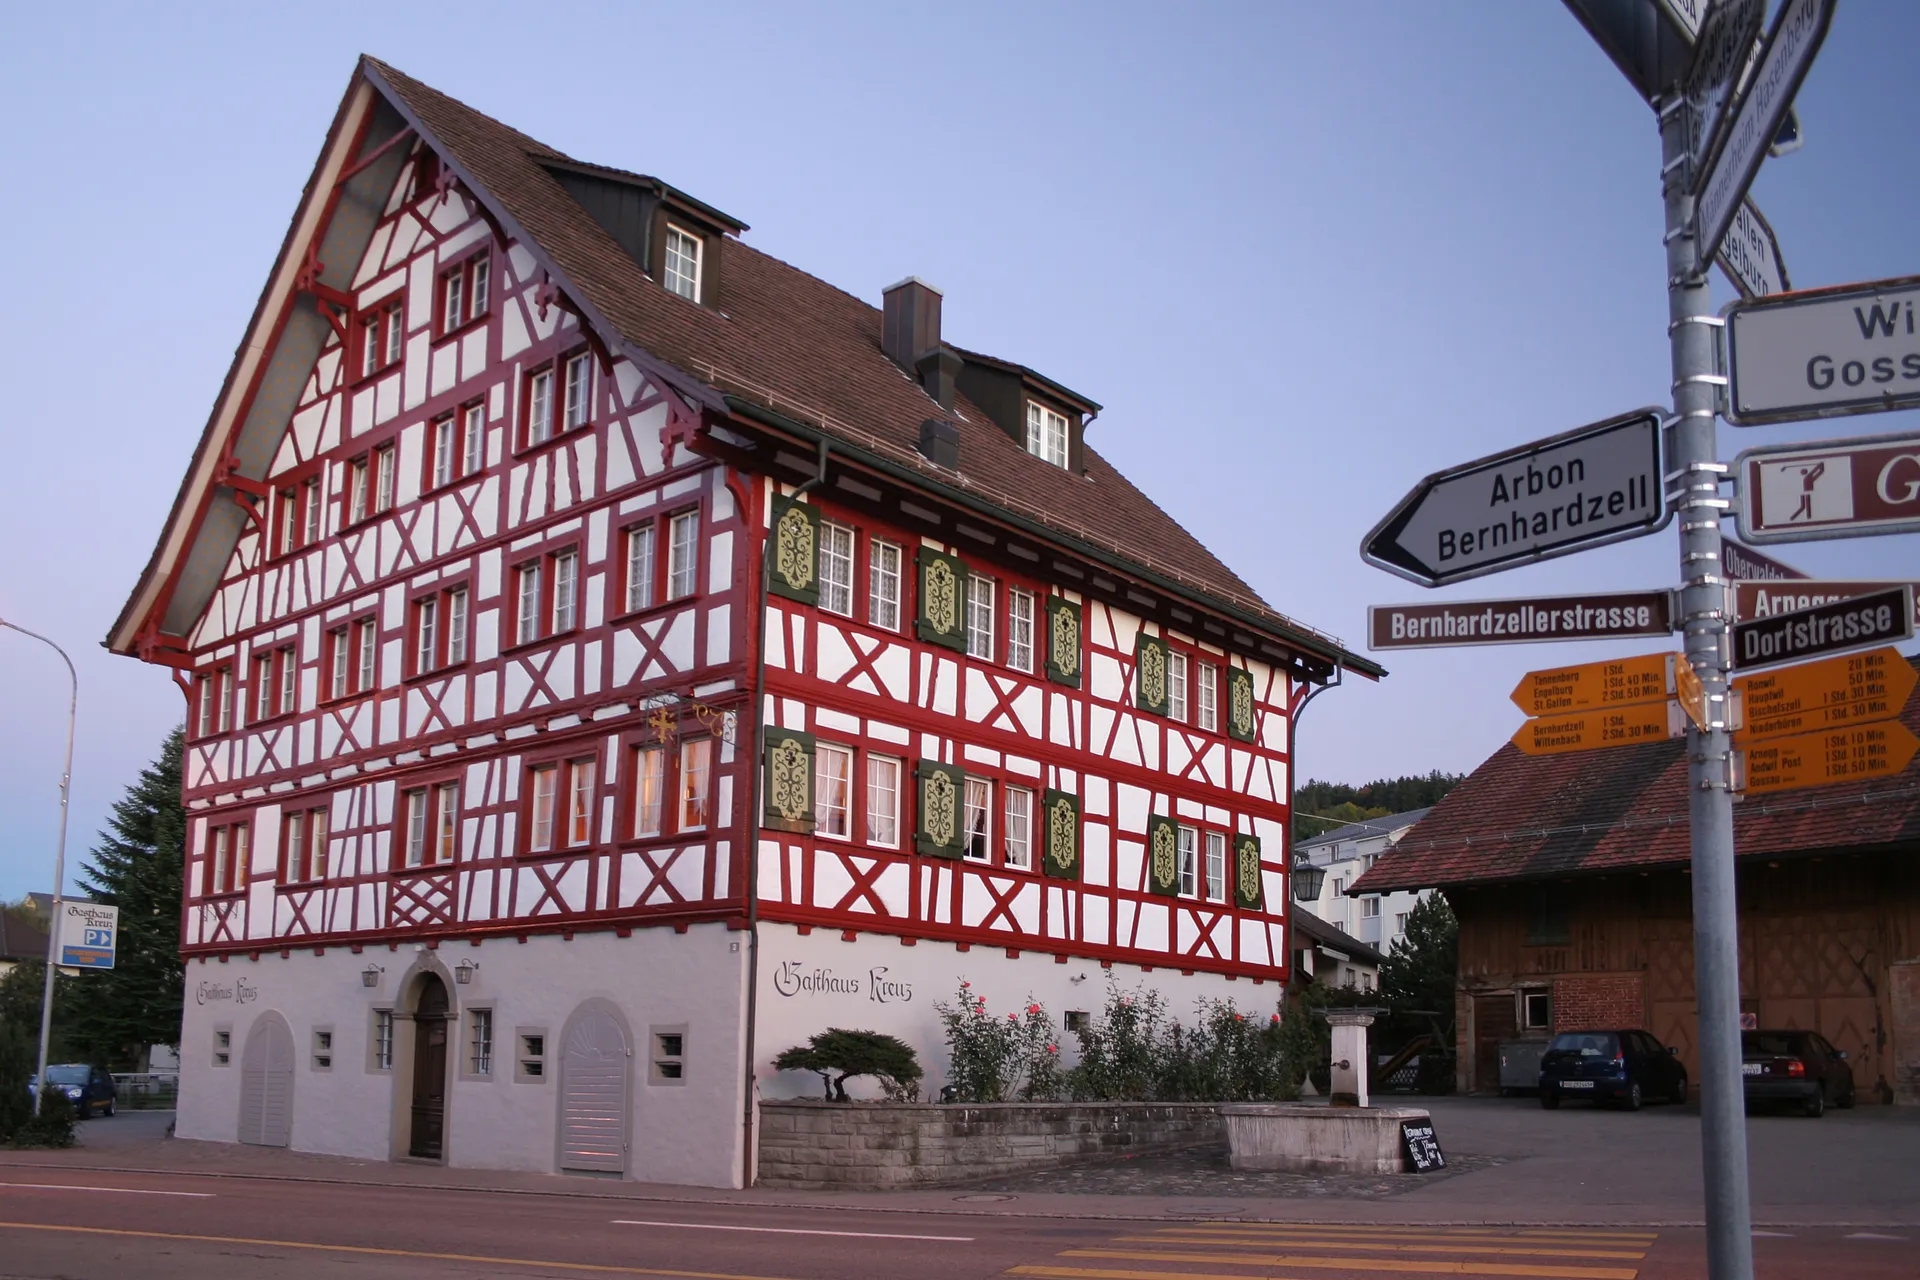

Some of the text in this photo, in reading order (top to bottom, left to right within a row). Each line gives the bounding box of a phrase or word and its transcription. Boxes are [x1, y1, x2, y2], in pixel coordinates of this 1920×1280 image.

[1755, 2, 1815, 119] Hasenberg
[1853, 301, 1914, 339] Wi
[1806, 353, 1920, 390] Goss
[1489, 458, 1585, 507] Arbon
[1438, 474, 1647, 561] Bernhardzell
[1391, 604, 1650, 639] Bernhardzellerstrasse
[1744, 604, 1892, 660] Dorfstrasse
[1848, 659, 1862, 671] 20
[1849, 671, 1863, 685] 50
[1865, 669, 1888, 681] Min.
[1533, 686, 1573, 699] Engelburg
[1609, 677, 1626, 688] Std.
[1627, 674, 1639, 685] 40
[1641, 672, 1661, 684] Min.
[1534, 672, 1579, 686] Tannenberg
[1602, 691, 1608, 702] 2
[1610, 690, 1626, 701] Std.
[1627, 687, 1640, 699] 50
[1642, 685, 1662, 697] Min.
[1749, 697, 1801, 718] Bischofszell
[1851, 686, 1864, 699] 30
[1852, 703, 1865, 717] 30
[1533, 720, 1585, 736] Bernhardzell
[1534, 733, 1582, 748] Wittenbach
[1602, 729, 1608, 740] 2
[1628, 726, 1641, 738] 30
[1643, 724, 1662, 736] Min.
[1830, 735, 1848, 748] Std.
[1851, 732, 1864, 744] 10
[1781, 756, 1802, 769] Post
[1853, 746, 1865, 758] 10
[1749, 775, 1780, 787] Gossau
[1851, 760, 1865, 773] 50
[68, 906, 114, 920] Gasthaus
[85, 917, 113, 931] Kreuz
[86, 930, 97, 944] P
[869, 967, 913, 1004] Kreuz
